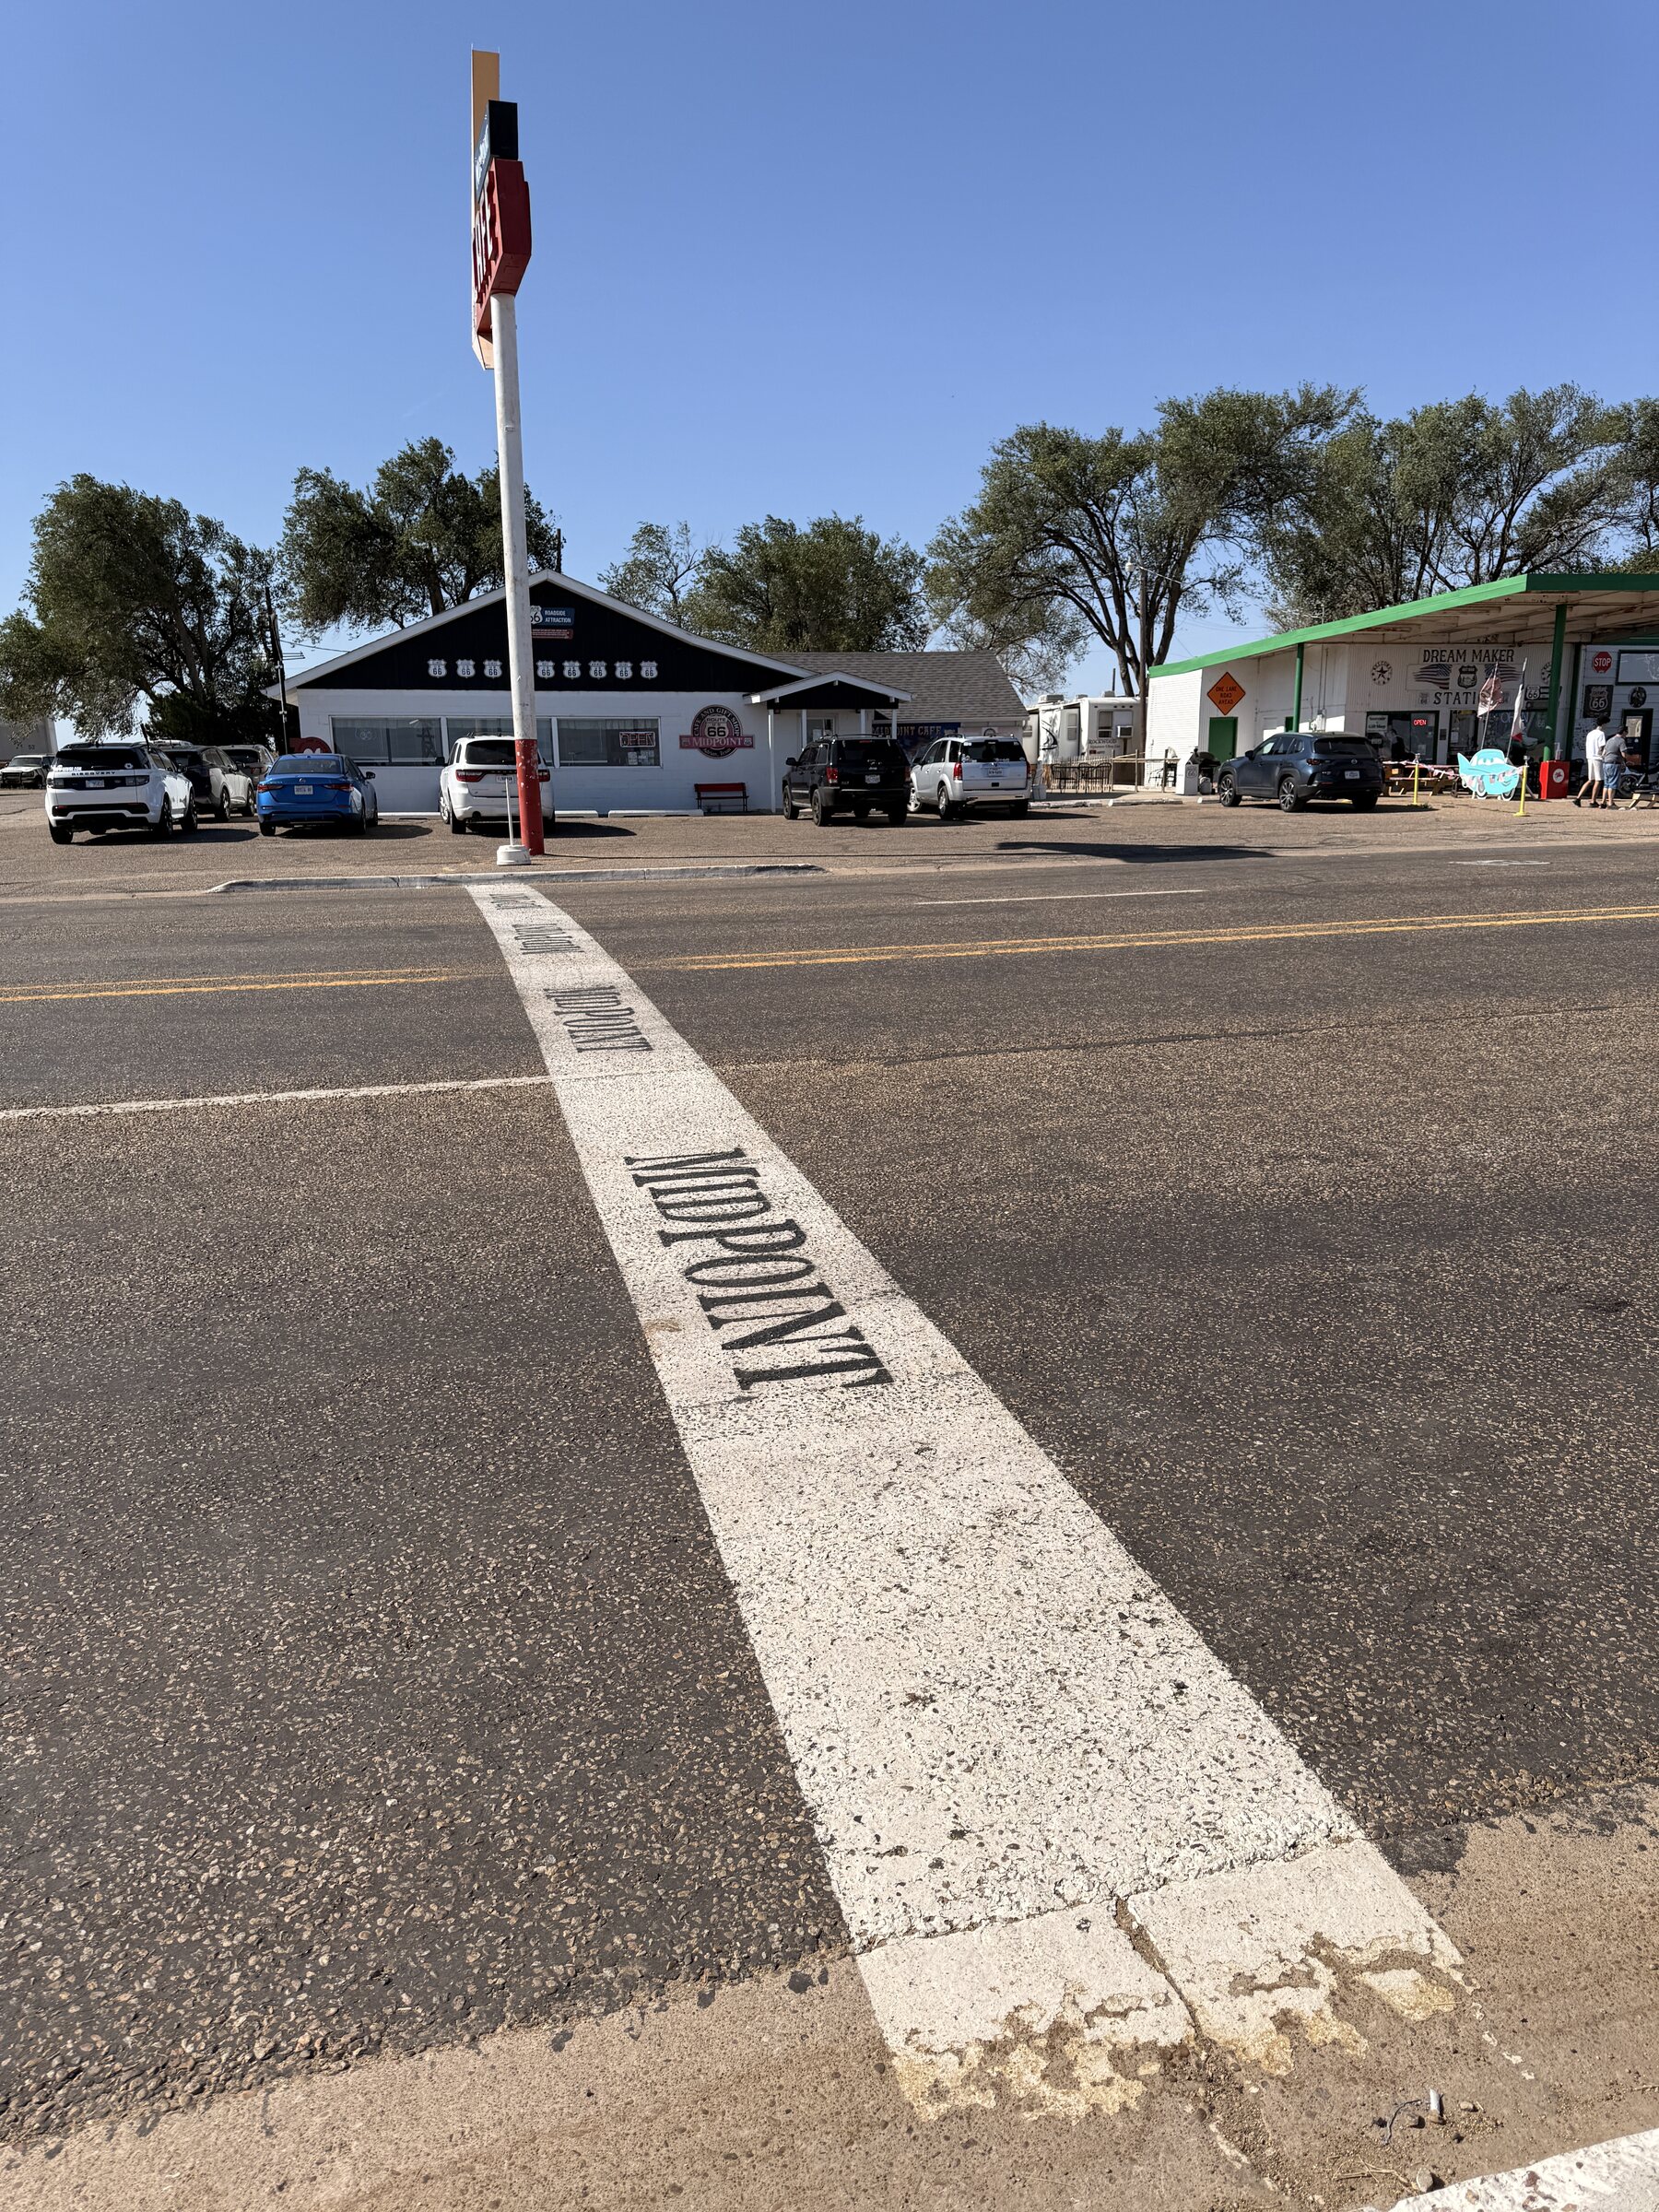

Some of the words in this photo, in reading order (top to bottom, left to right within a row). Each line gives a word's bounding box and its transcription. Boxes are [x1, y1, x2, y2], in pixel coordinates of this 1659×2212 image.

[1422, 649, 1466, 663] DREAM
[1471, 649, 1514, 663] MAKER
[1594, 657, 1612, 667] STOP
[432, 667, 442, 676] 66
[1433, 691, 1480, 705] STATI
[1592, 698, 1605, 709] 66
[700, 708, 714, 718] AND
[716, 708, 732, 718] GIFT
[731, 717, 740, 736] SHOP
[707, 726, 726, 737] 66
[872, 726, 916, 736] MIDOINT
[918, 725, 942, 736] CAFE
[620, 733, 654, 746] OPEN
[692, 737, 743, 747] MIDPOINT
[543, 985, 653, 1053] MIDPOINT
[623, 1147, 894, 1391] MIDPOINT
